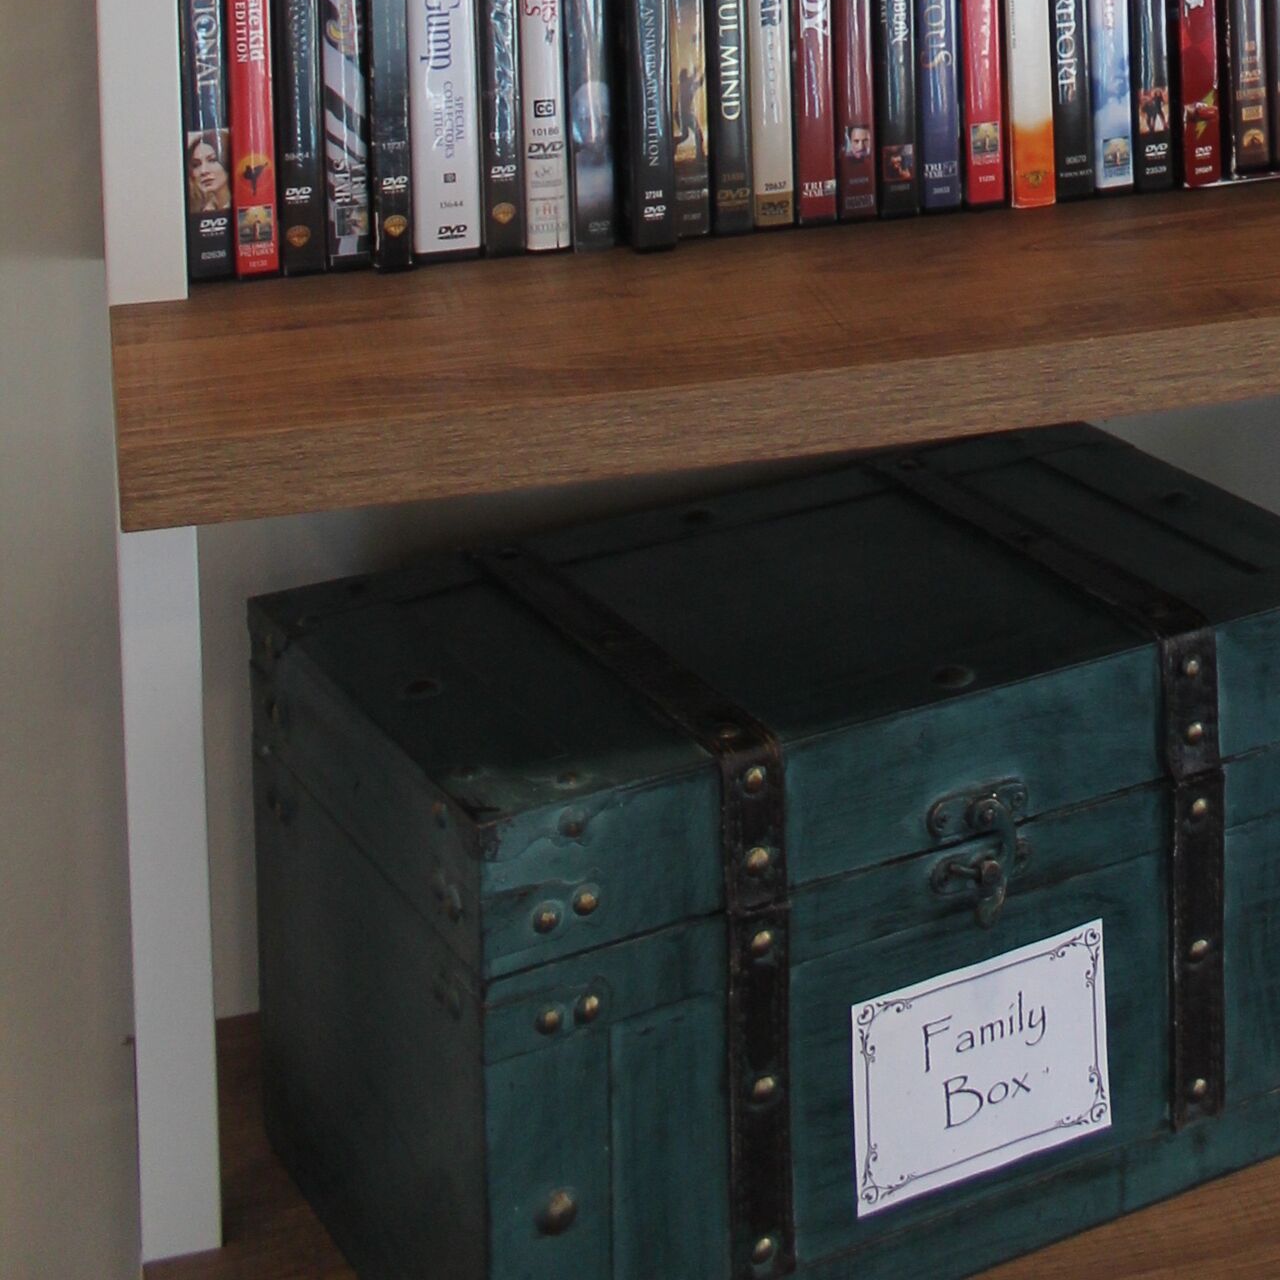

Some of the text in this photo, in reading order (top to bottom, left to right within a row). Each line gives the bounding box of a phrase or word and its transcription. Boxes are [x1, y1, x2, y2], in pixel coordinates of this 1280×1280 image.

[235, 1, 247, 63] EDITION
[248, 27, 265, 61] Kid
[643, 6, 658, 101] ANNIVERSARY
[719, 44, 741, 121] MIND
[455, 95, 466, 142] SPECIAL
[531, 128, 560, 137] 10186
[645, 106, 661, 168] EDITION
[528, 141, 564, 154] DVD
[1144, 143, 1169, 153] DVD
[491, 165, 517, 174] DVD
[382, 176, 408, 186] DVD
[803, 181, 823, 190] TRI
[286, 187, 312, 197] DVD
[717, 188, 751, 200] DVD
[802, 189, 825, 198] STAR
[644, 205, 667, 214] DVD
[201, 218, 227, 228] DVD
[438, 225, 468, 235] DVD
[921, 990, 1047, 1073] Family
[943, 1072, 1031, 1130] Box
